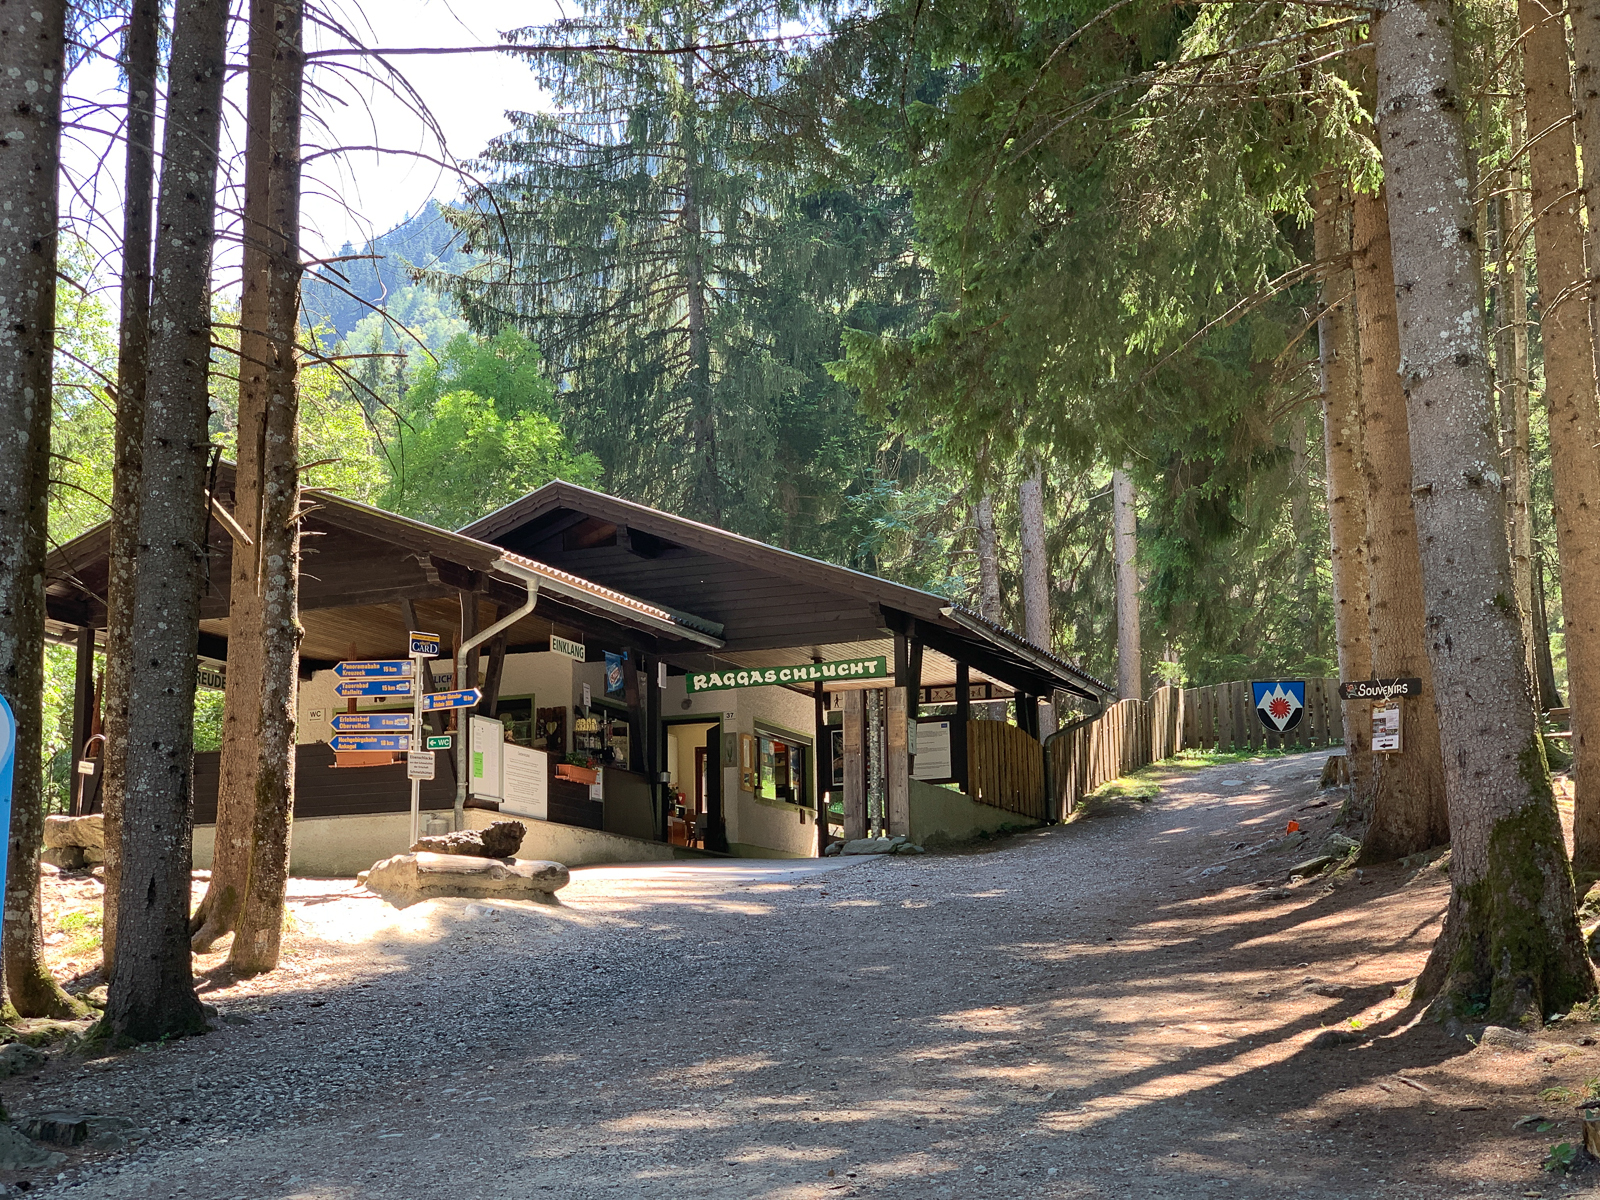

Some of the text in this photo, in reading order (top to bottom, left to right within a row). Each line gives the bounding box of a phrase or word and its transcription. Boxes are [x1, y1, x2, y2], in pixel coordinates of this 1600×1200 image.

[412, 641, 438, 653] CARD
[552, 638, 584, 659] EINKLANG
[693, 660, 878, 691] RAGGASCHLUCHT
